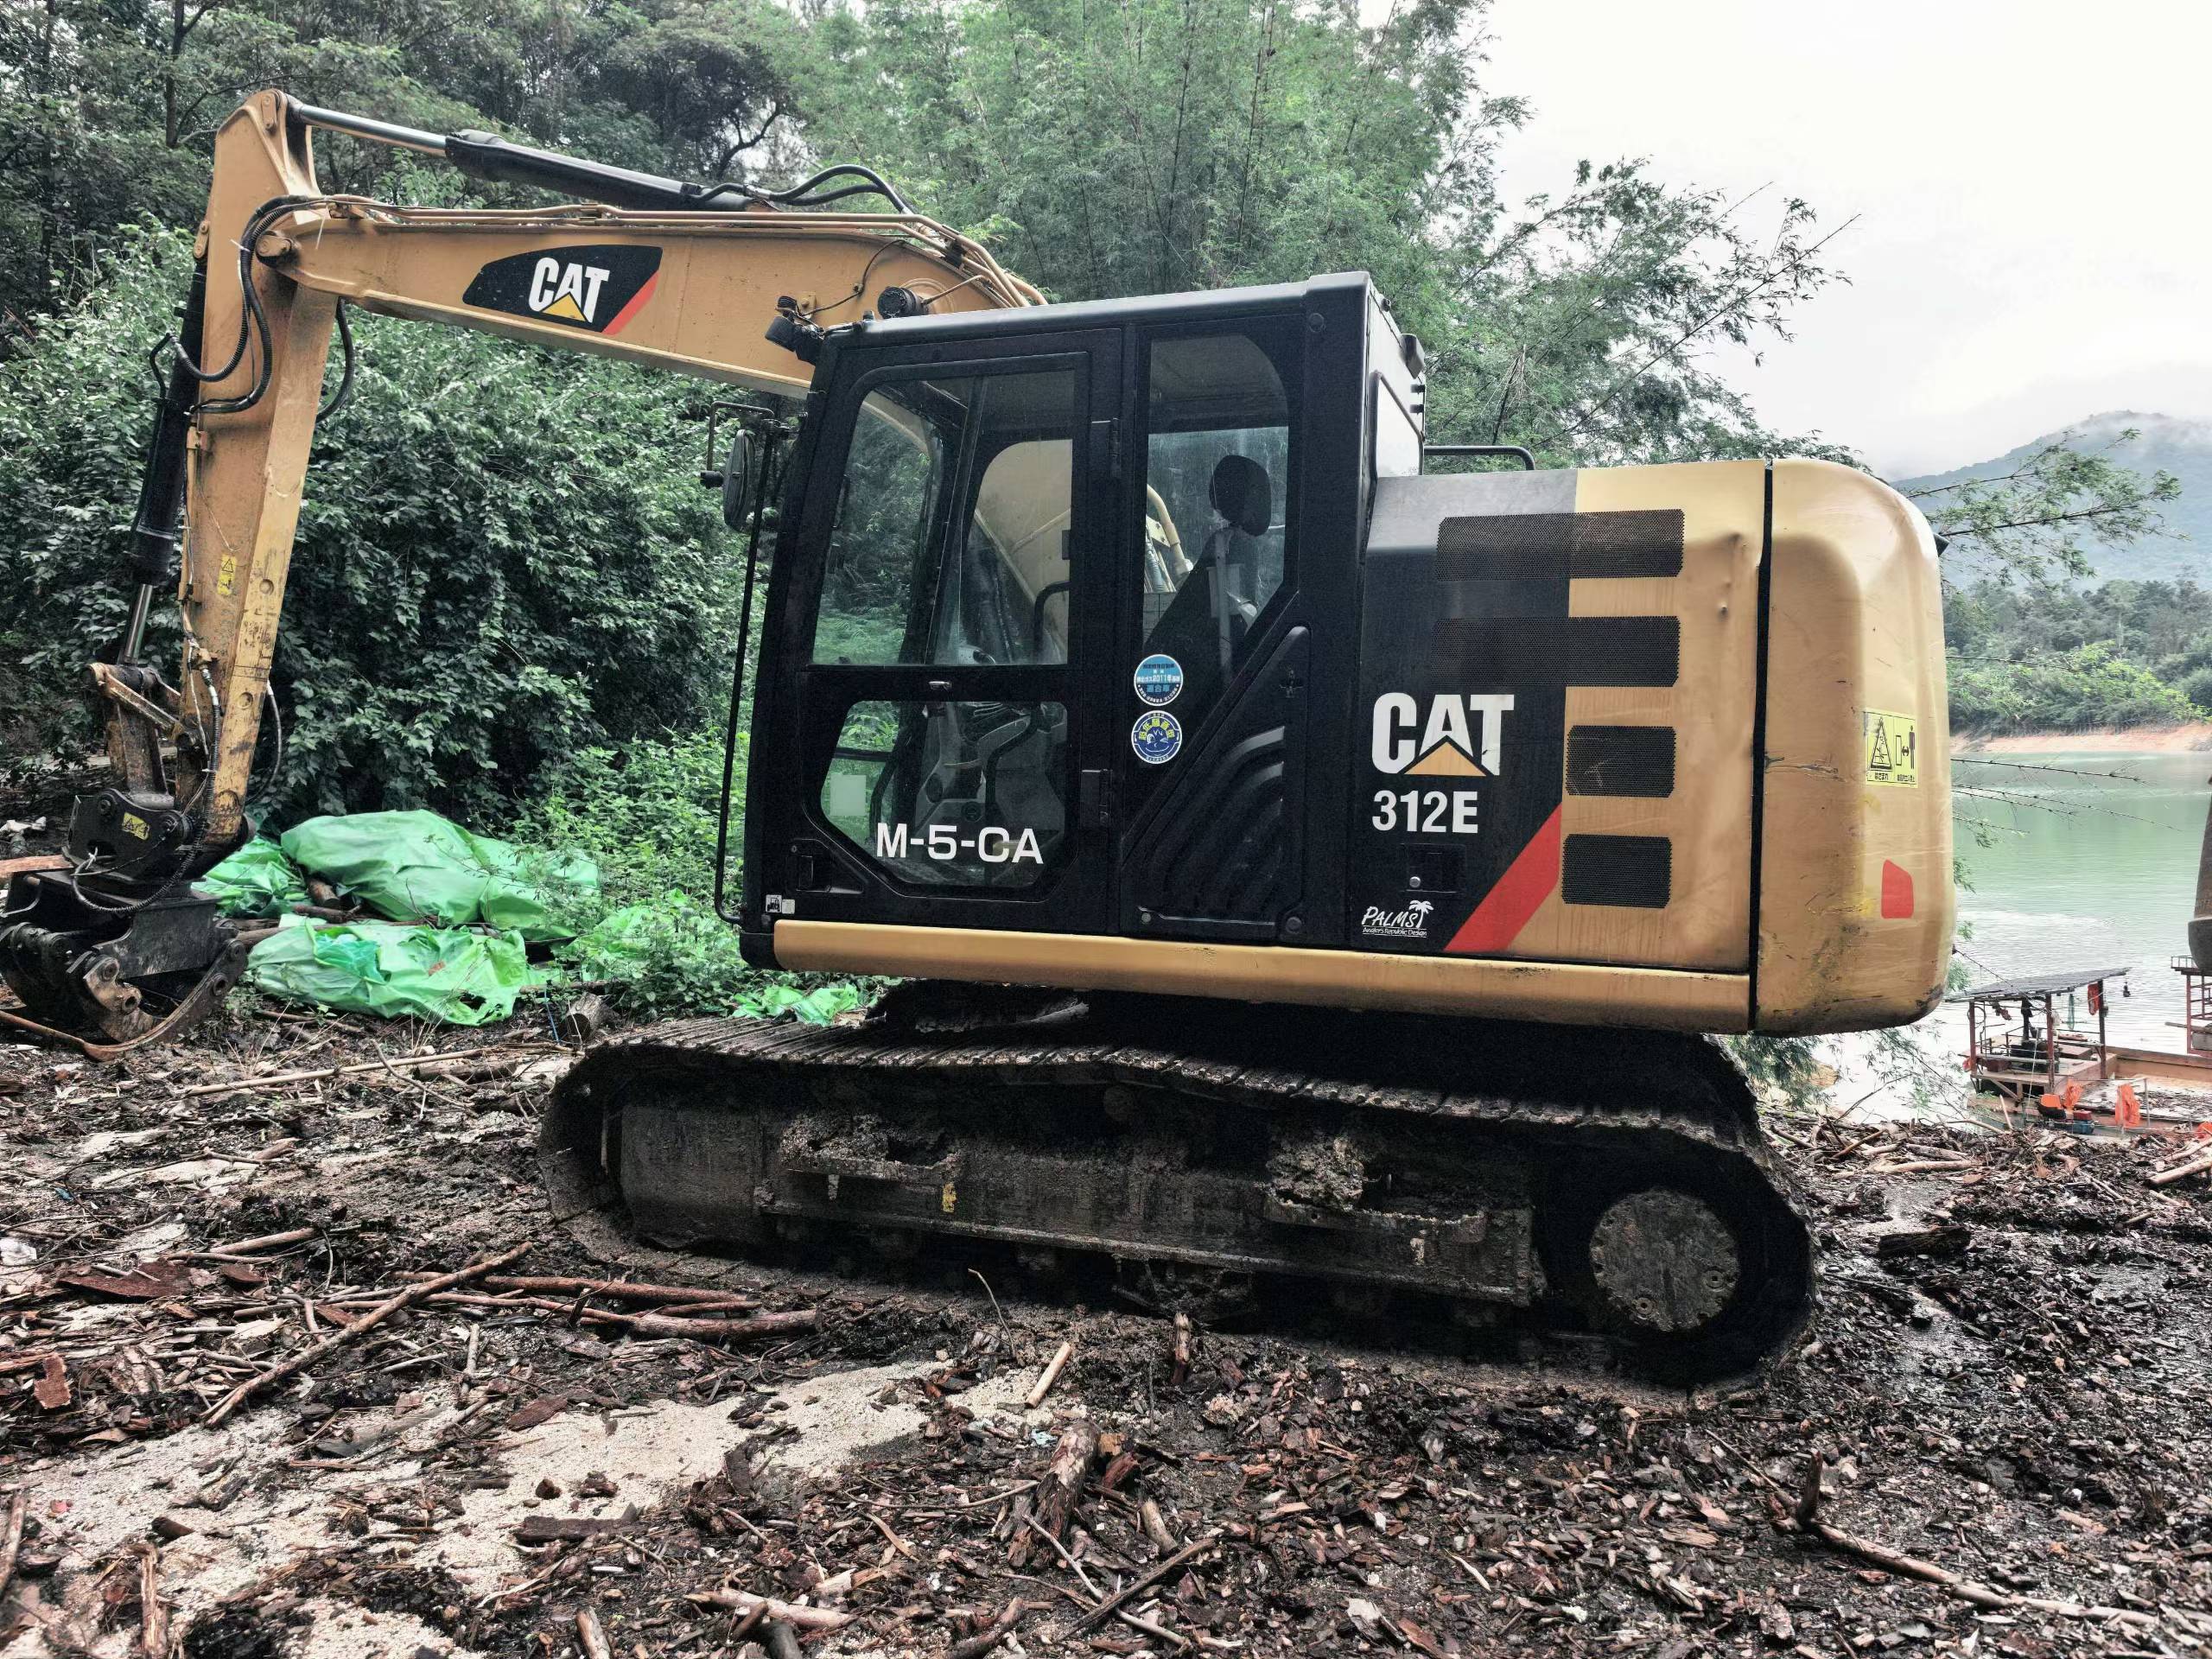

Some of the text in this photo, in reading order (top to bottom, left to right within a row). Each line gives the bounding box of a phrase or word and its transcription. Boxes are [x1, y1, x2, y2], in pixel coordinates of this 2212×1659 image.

[528, 257, 610, 323] CAT
[1372, 692, 1515, 776] CAT
[1372, 790, 1478, 833] 312E
[876, 823, 1044, 864] M-5-CA
[1361, 906, 1419, 928] PALMS
